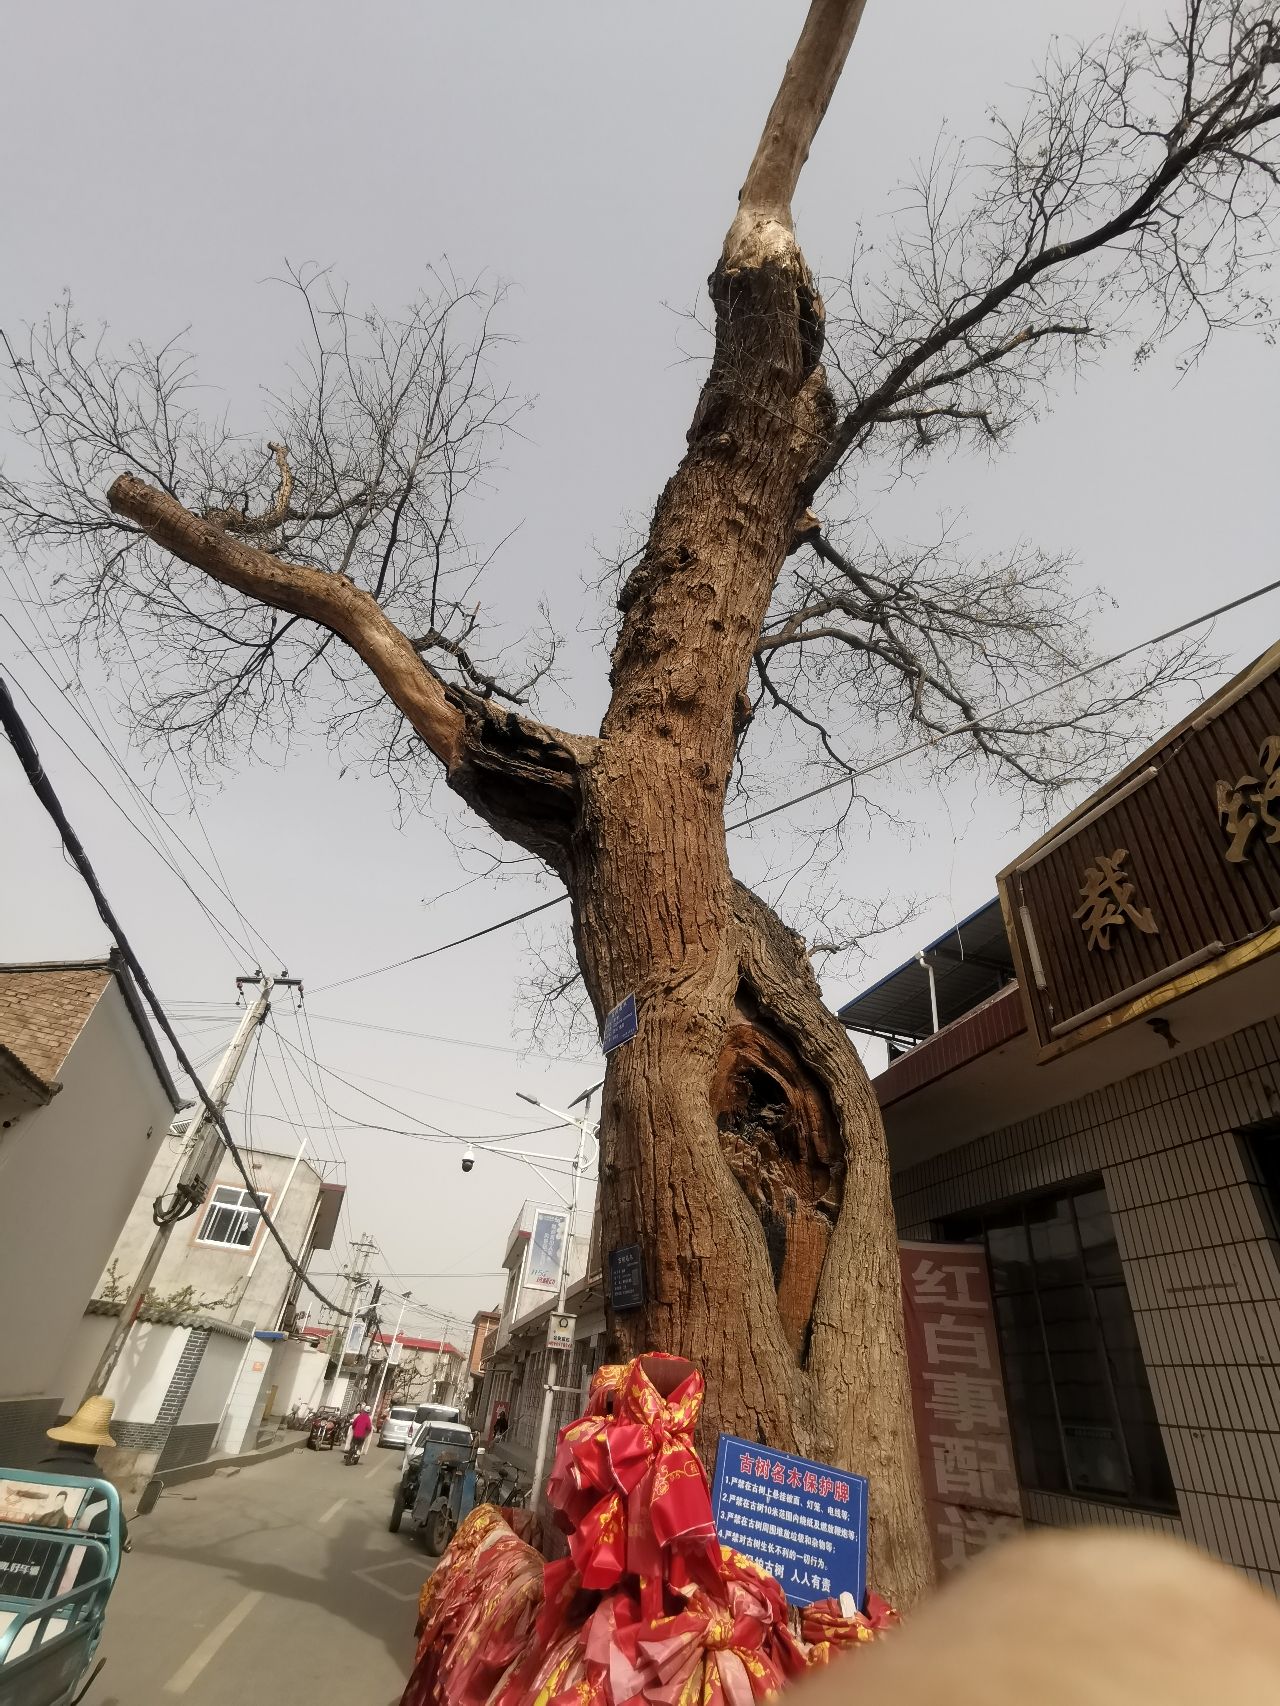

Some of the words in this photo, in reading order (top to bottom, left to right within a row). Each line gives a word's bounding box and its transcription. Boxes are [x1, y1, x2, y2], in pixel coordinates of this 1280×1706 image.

[740, 1453, 850, 1504] 古树名木保护牌
[790, 1570, 832, 1593] 人人有责
